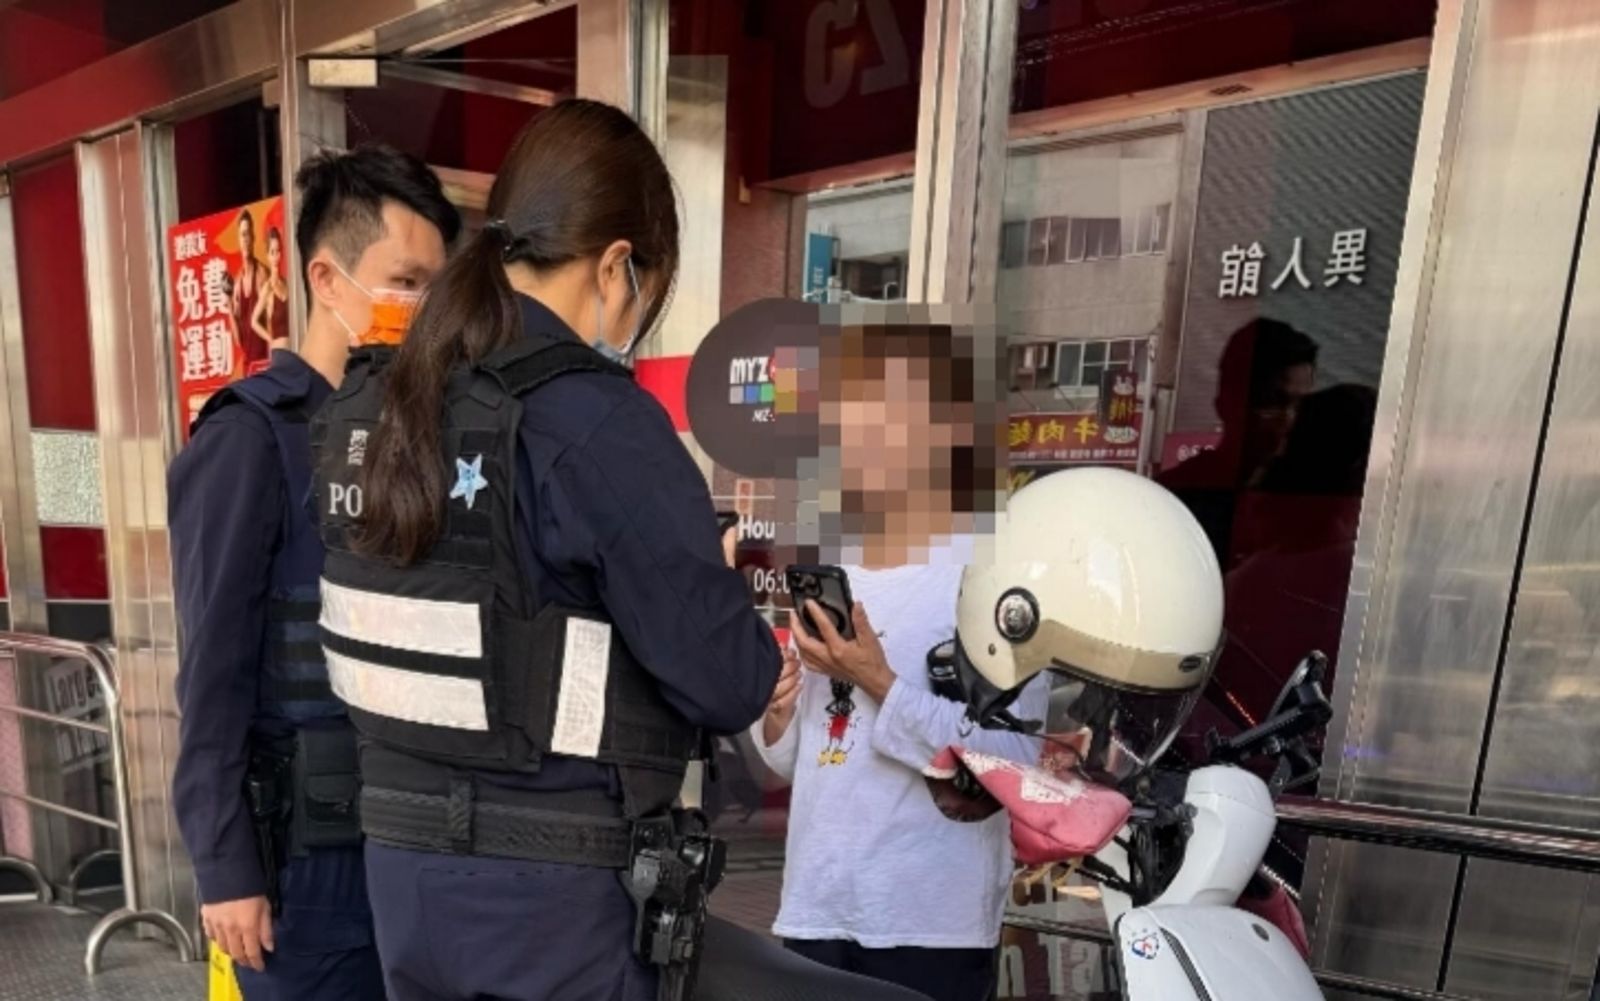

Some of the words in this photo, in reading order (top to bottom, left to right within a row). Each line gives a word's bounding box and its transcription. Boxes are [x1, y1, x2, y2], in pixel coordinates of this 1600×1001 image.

[176, 257, 231, 323] 免費
[180, 319, 234, 381] 運動
[729, 356, 775, 384] MYZ
[328, 482, 363, 517] PO
